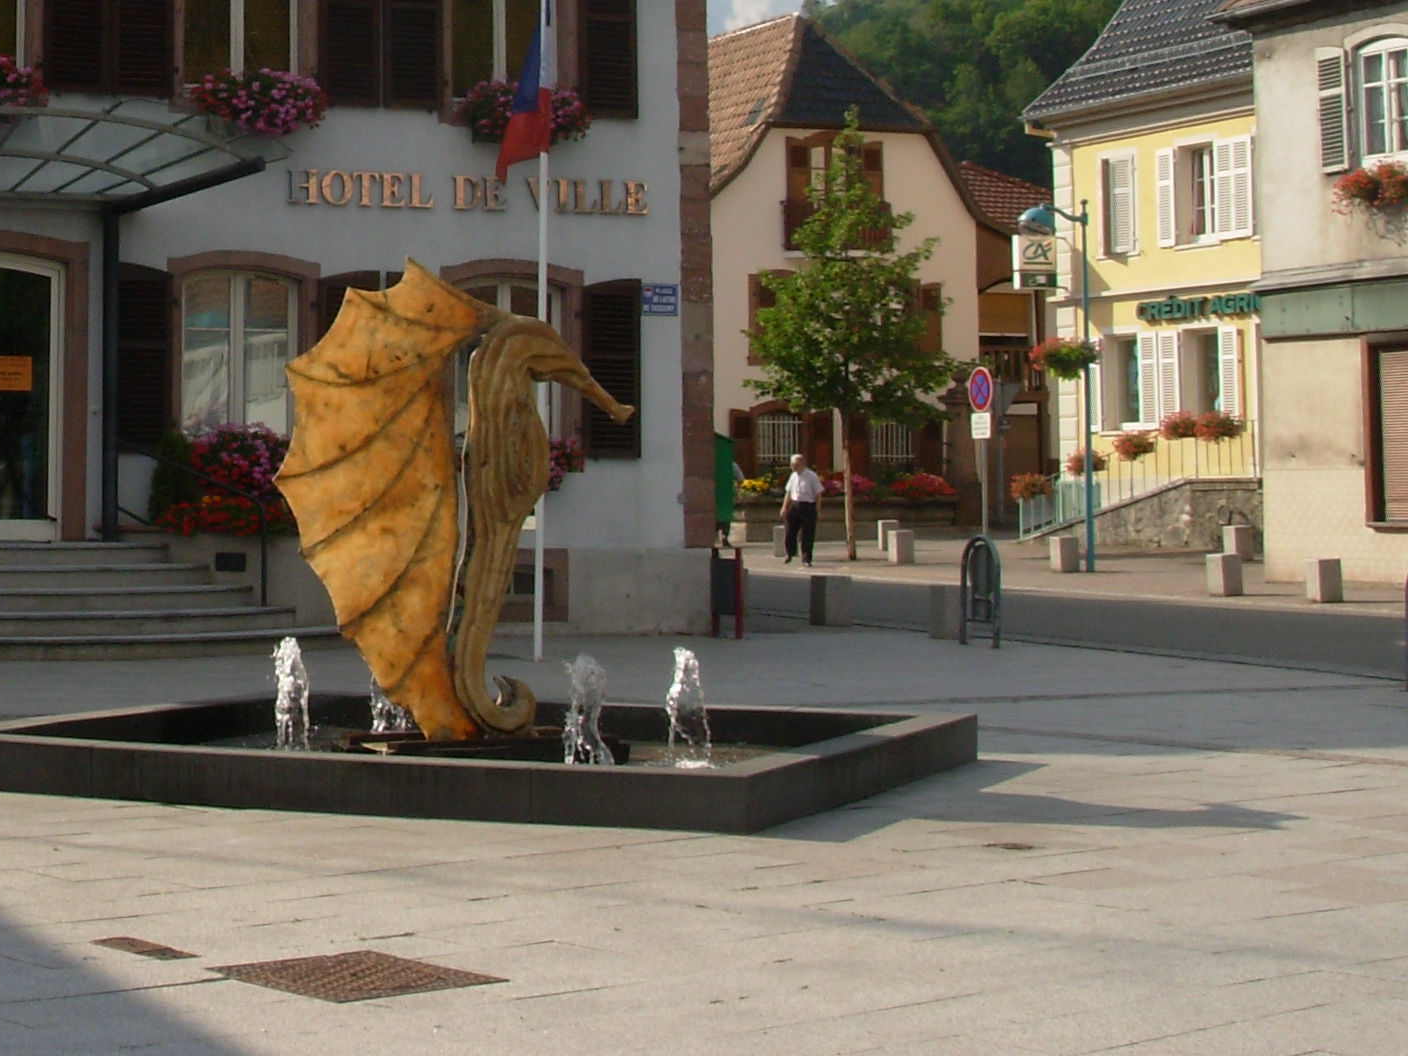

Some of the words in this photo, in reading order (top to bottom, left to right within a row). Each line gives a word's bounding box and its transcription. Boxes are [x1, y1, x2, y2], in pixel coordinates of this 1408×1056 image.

[288, 169, 434, 209] HOTEL
[453, 174, 508, 211] DE
[525, 177, 649, 215] VILLE
[1136, 296, 1207, 321] CRÉDIT
